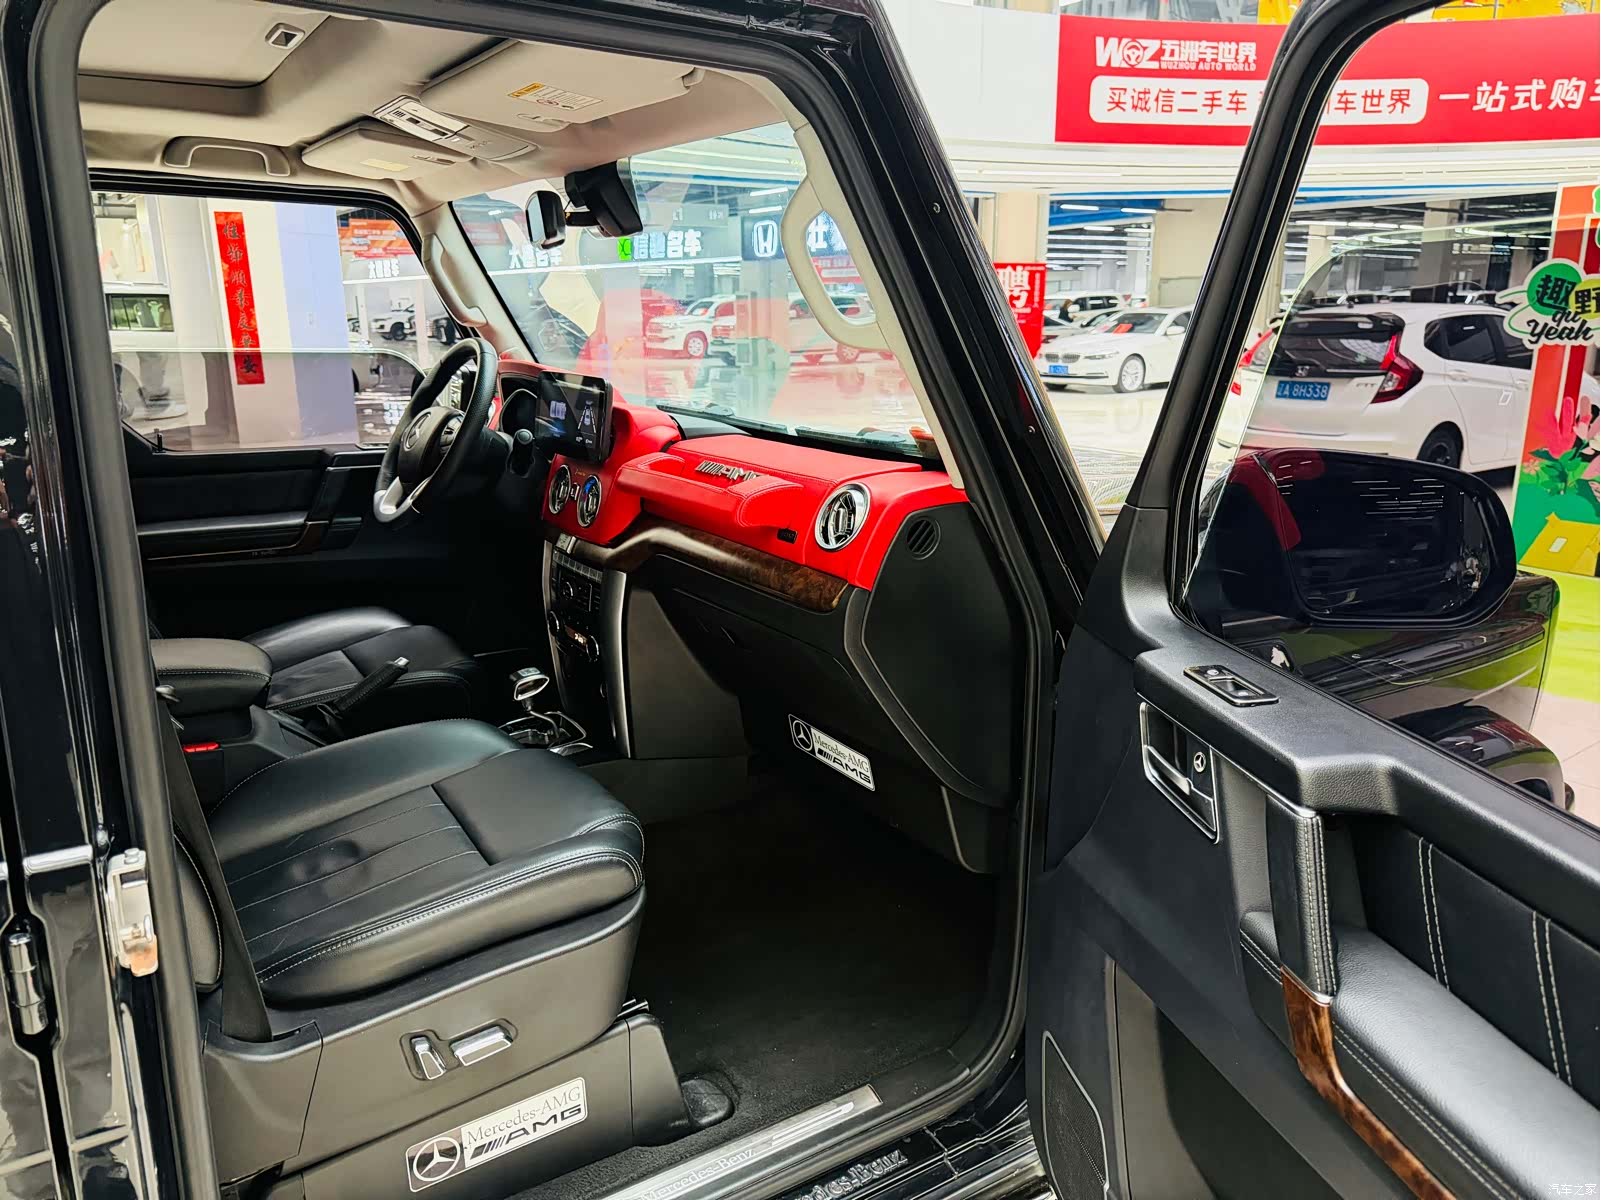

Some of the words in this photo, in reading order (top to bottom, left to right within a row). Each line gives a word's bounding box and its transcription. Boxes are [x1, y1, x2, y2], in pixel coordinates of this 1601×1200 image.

[1161, 40, 1257, 63] 五洲车世界
[1161, 60, 1196, 70] WUZHOU
[1198, 61, 1222, 70] AUTO
[1225, 62, 1256, 71] WORLD
[1107, 87, 1247, 115] 买诚信二手车
[466, 1086, 581, 1145] Mercedes-AMG
[504, 1103, 582, 1146] AMG
